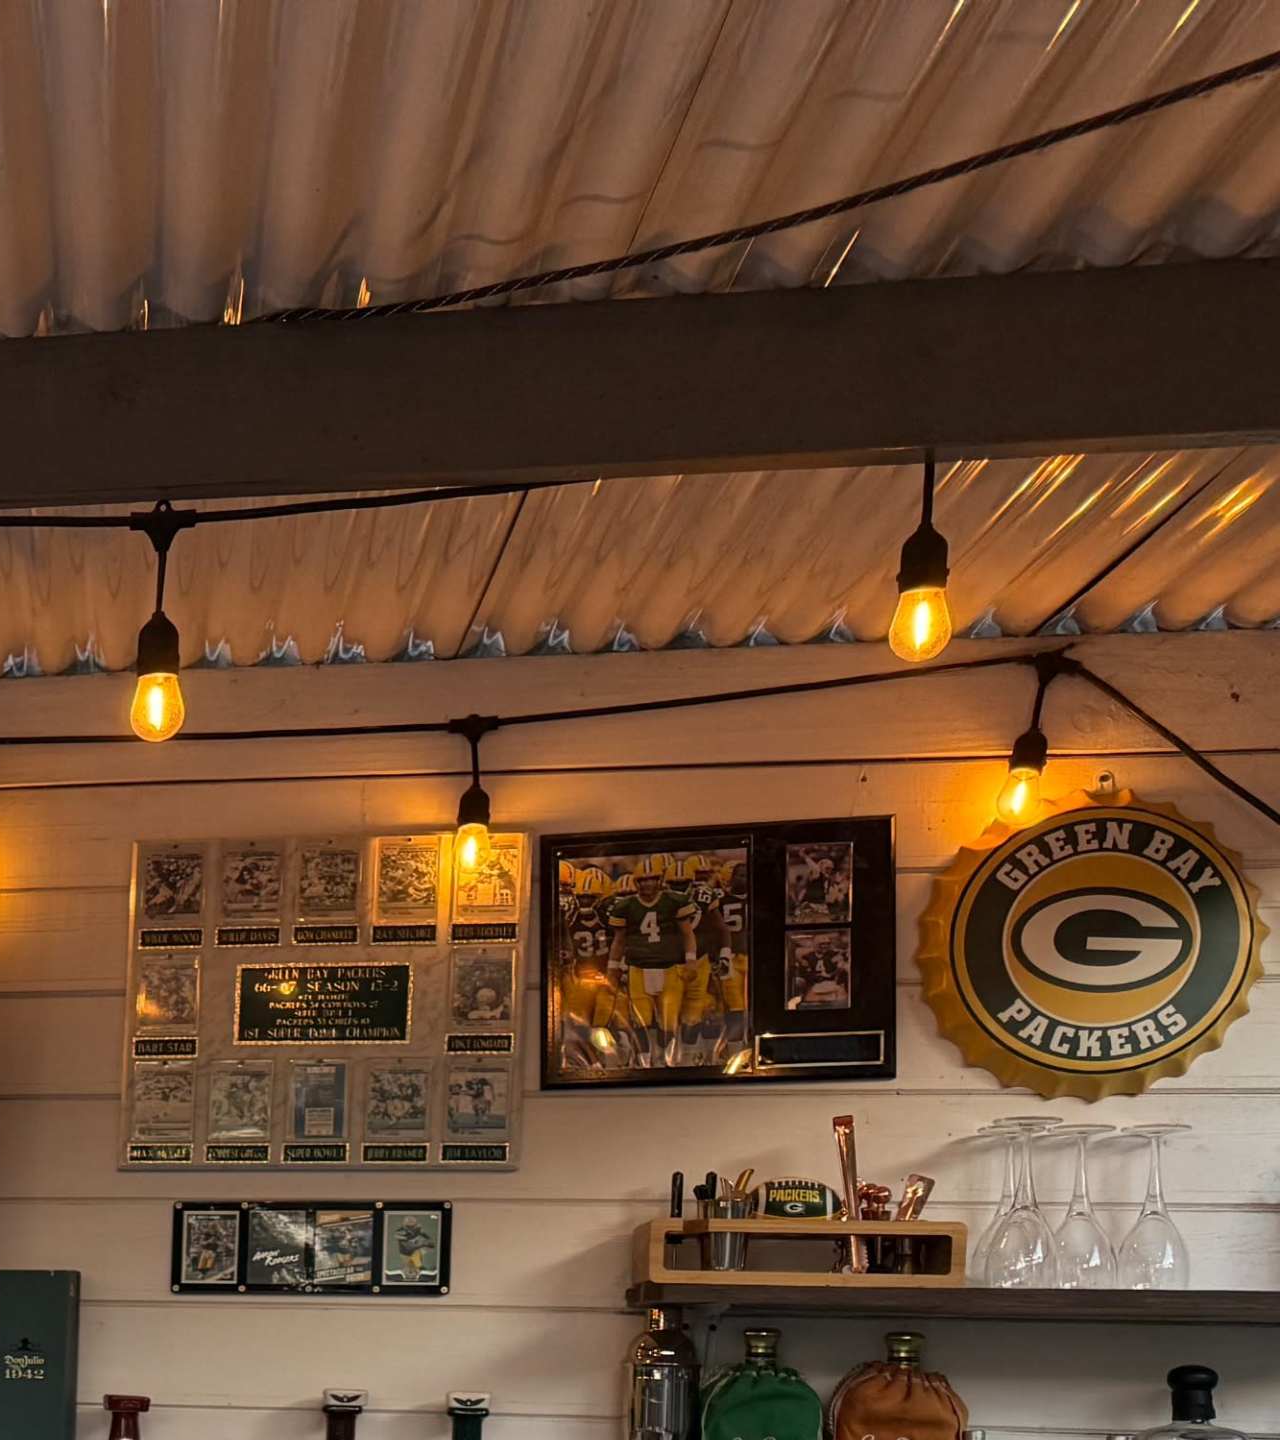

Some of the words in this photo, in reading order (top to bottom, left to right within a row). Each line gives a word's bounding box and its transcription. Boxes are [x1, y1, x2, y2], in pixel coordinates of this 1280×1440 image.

[996, 822, 1134, 892] GREEN
[1143, 831, 1222, 895] BAY
[640, 912, 661, 943] 4
[306, 968, 328, 980] BAY
[338, 967, 387, 979] PACKERS
[306, 980, 360, 993] SEASON
[997, 998, 1189, 1058] PACKERS
[768, 1189, 820, 1203] PACKERS
[5, 1368, 45, 1379] 1942
